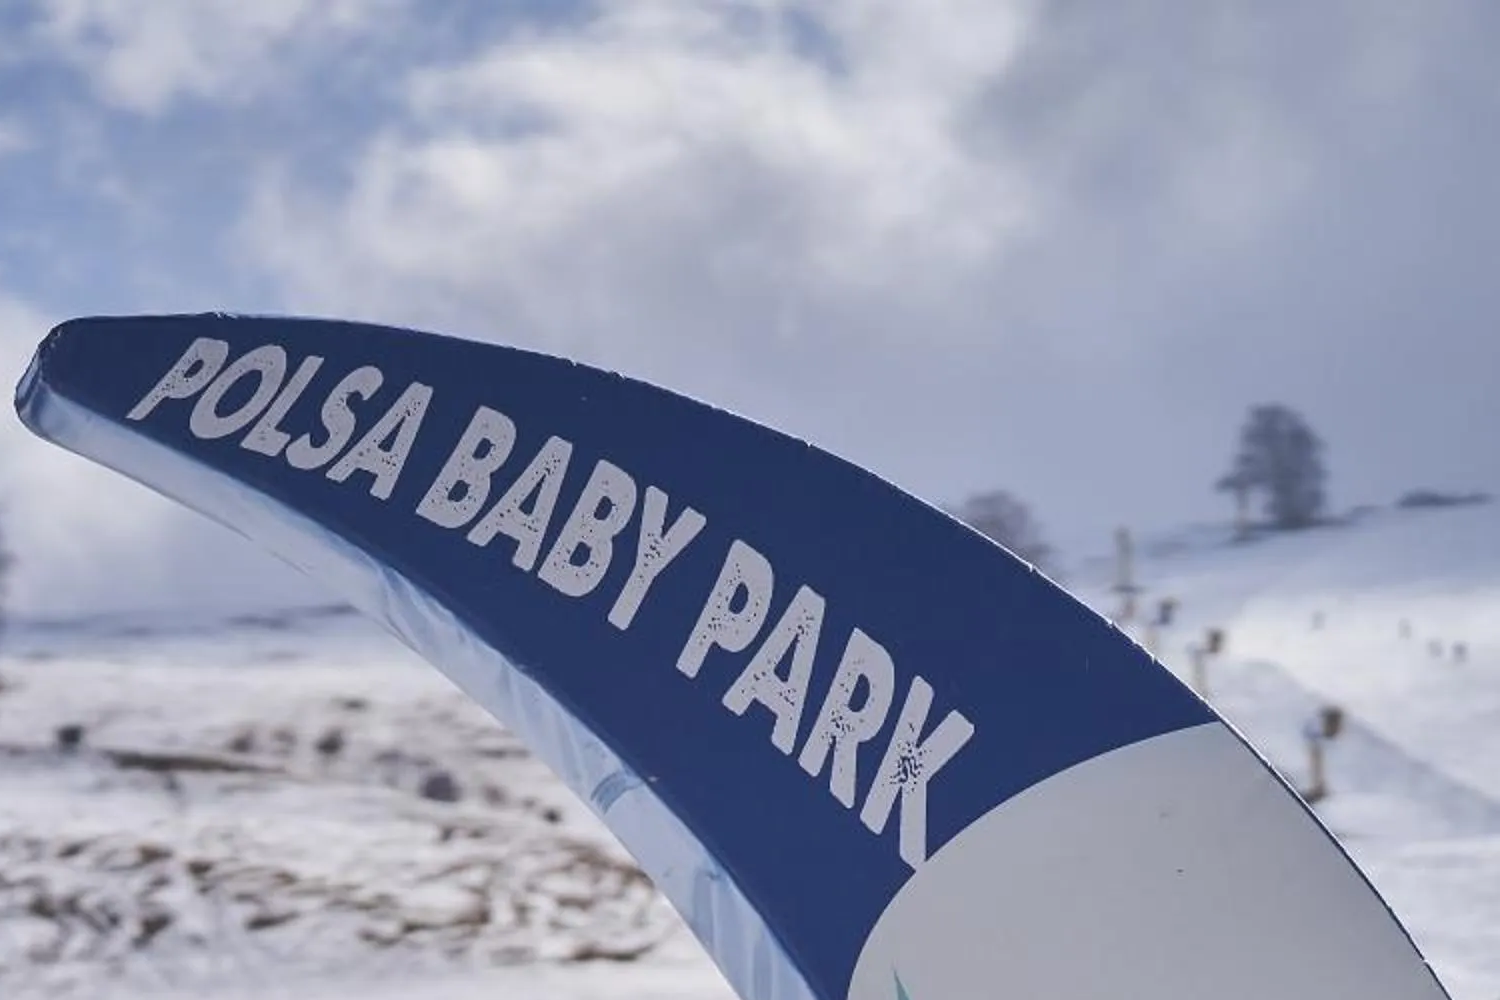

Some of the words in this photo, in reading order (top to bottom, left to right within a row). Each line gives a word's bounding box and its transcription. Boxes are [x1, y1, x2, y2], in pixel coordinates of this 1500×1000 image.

[126, 337, 434, 499] POLSA
[416, 405, 705, 630] BABY
[676, 539, 975, 871] PARK
